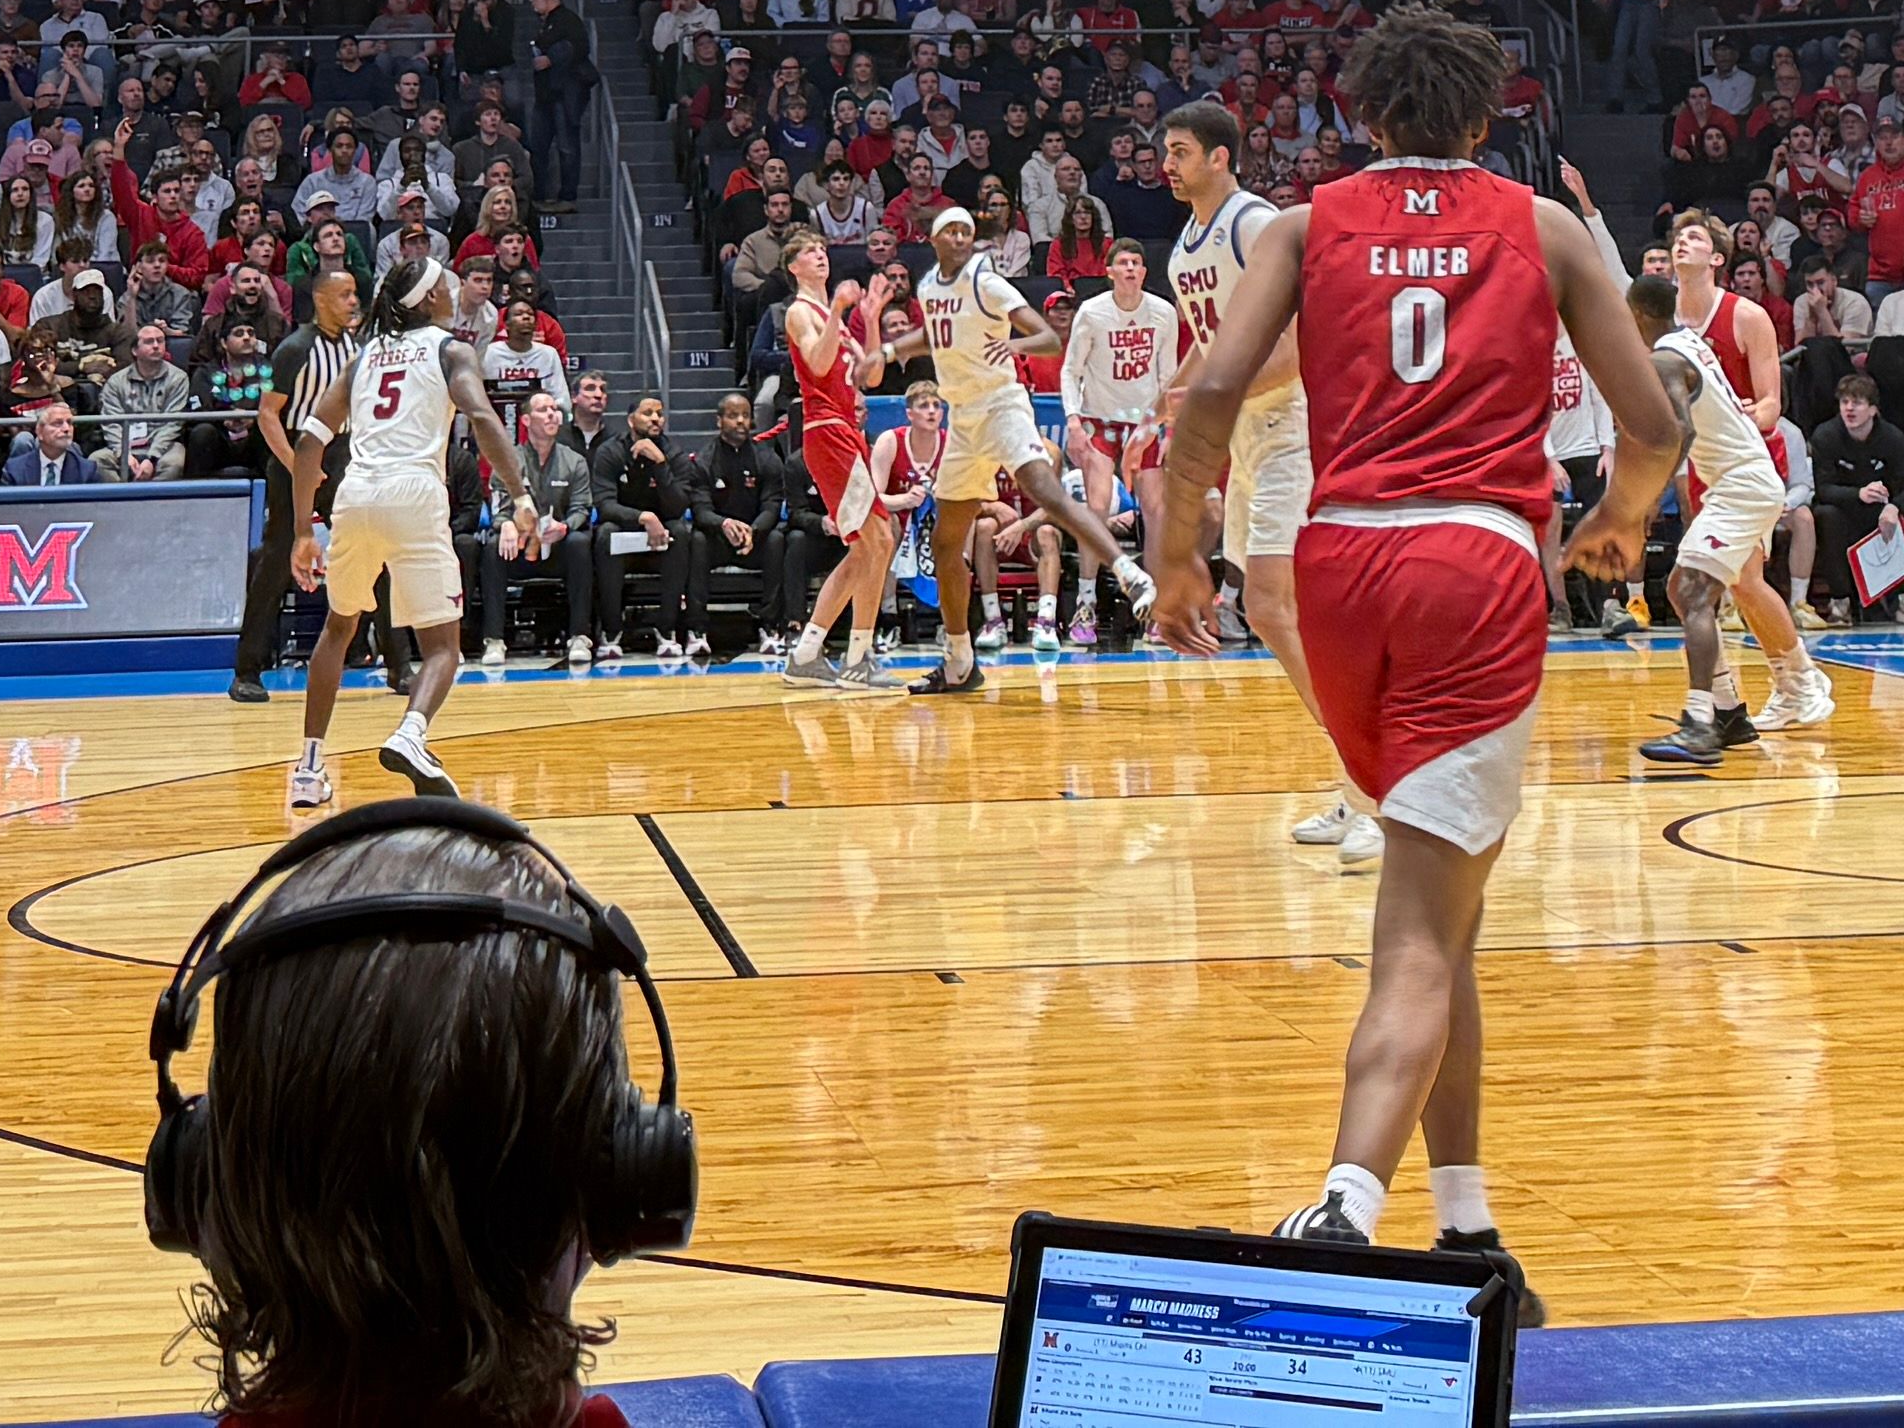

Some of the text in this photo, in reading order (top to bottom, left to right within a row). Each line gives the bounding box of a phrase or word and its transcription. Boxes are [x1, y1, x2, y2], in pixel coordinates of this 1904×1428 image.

[1404, 188, 1440, 217] M
[1370, 243, 1470, 277] ELMER
[1178, 264, 1219, 295] SMU
[926, 298, 964, 315] SMU
[932, 320, 952, 351] 10
[1109, 327, 1156, 350] LEGACY
[1391, 286, 1446, 385] 0
[1113, 359, 1151, 382] LOCK
[372, 370, 408, 420] 5
[1182, 1347, 1203, 1366] 43
[1287, 1358, 1308, 1377] 34
